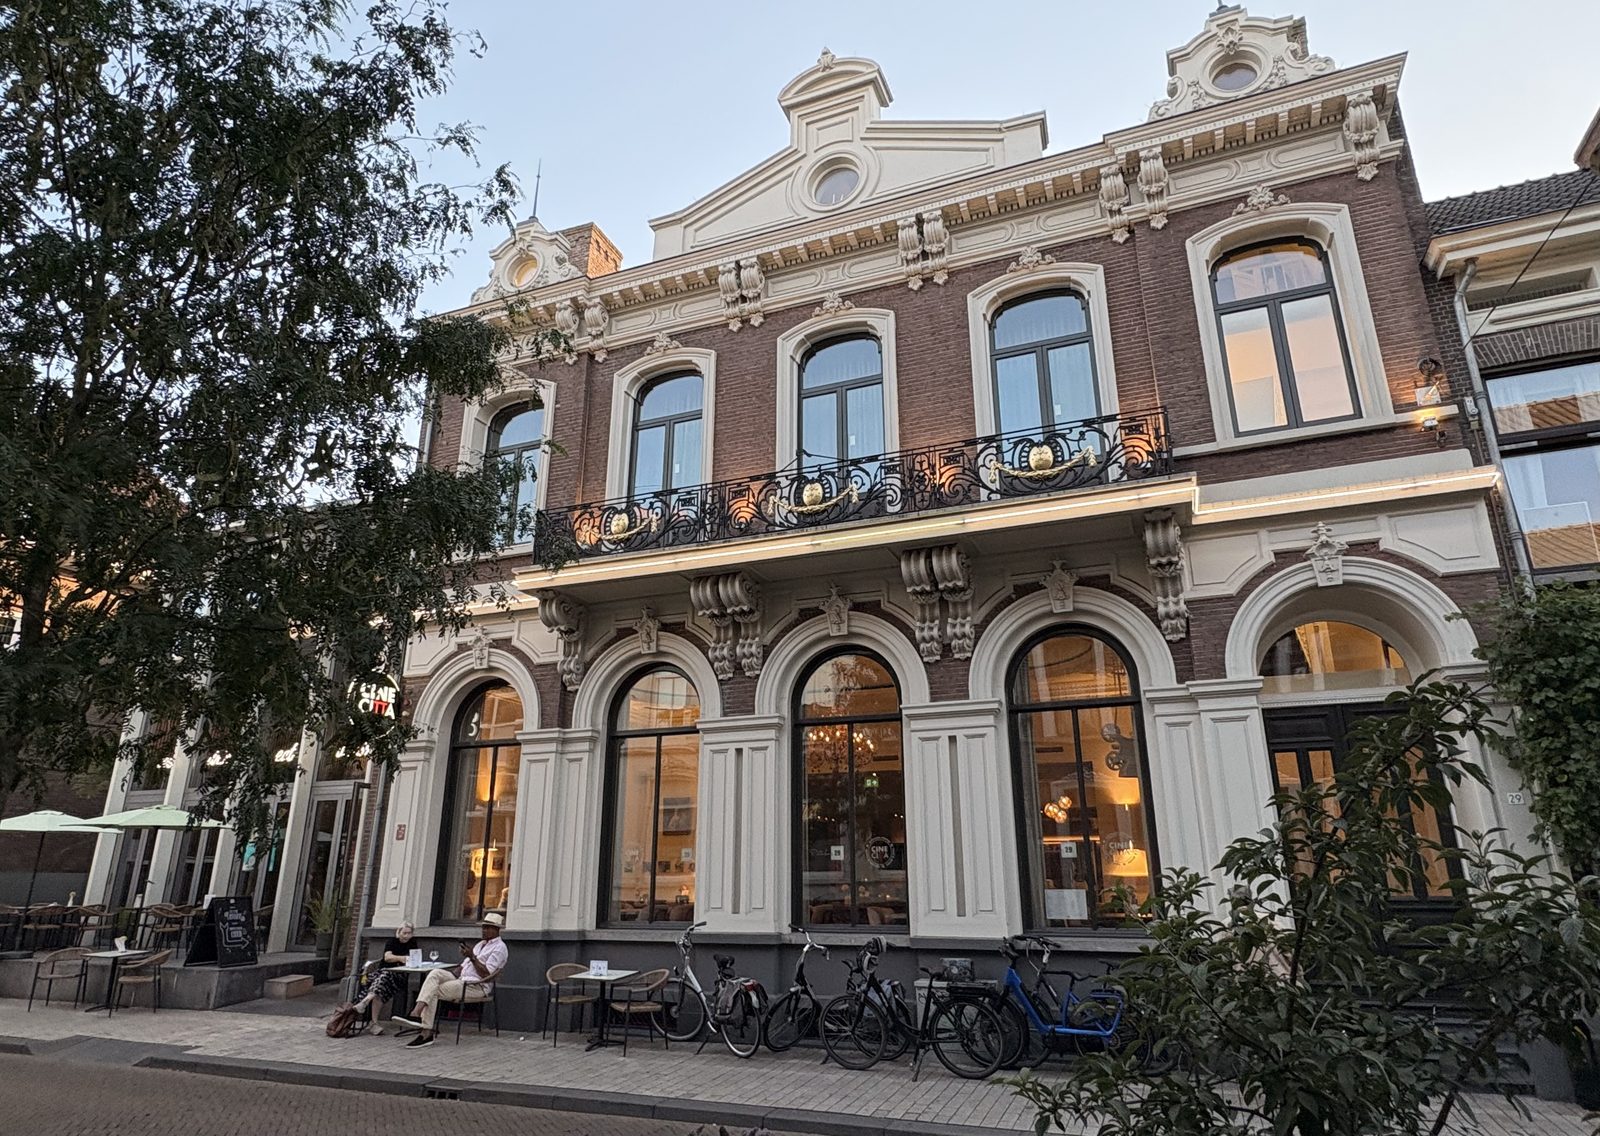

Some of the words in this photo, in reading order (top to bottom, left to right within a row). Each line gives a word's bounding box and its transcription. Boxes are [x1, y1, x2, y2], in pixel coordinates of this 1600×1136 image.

[360, 682, 397, 703] CINE
[358, 699, 395, 720] CITTA
[1508, 794, 1521, 804] 29
